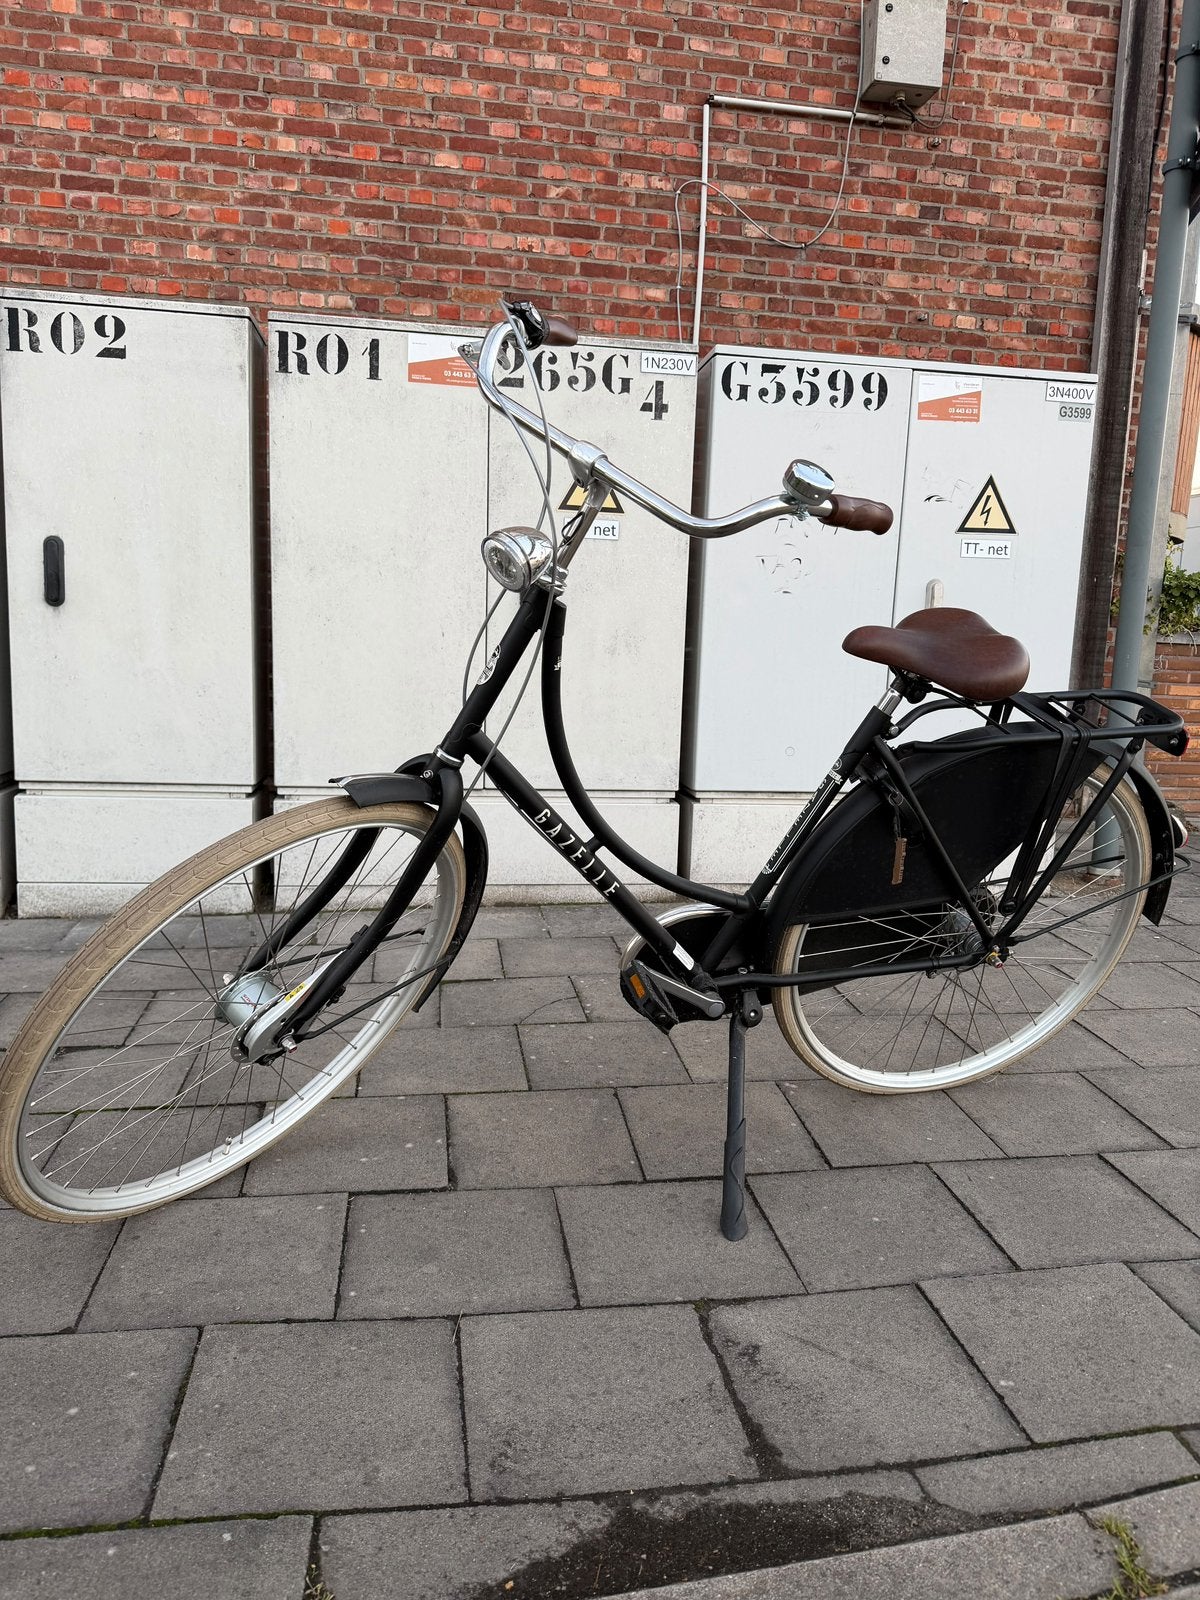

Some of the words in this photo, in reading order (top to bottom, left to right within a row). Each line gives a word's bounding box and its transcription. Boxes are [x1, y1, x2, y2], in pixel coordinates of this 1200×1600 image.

[496, 343, 634, 395] 265G
[643, 357, 694, 372] 1N230V
[721, 361, 889, 412] G3599
[1048, 385, 1095, 400] 3N400V
[640, 380, 669, 421] 4
[1059, 405, 1092, 419] G3599
[593, 523, 617, 537] net
[987, 544, 1009, 556] net
[534, 808, 620, 897] GAZELLE
